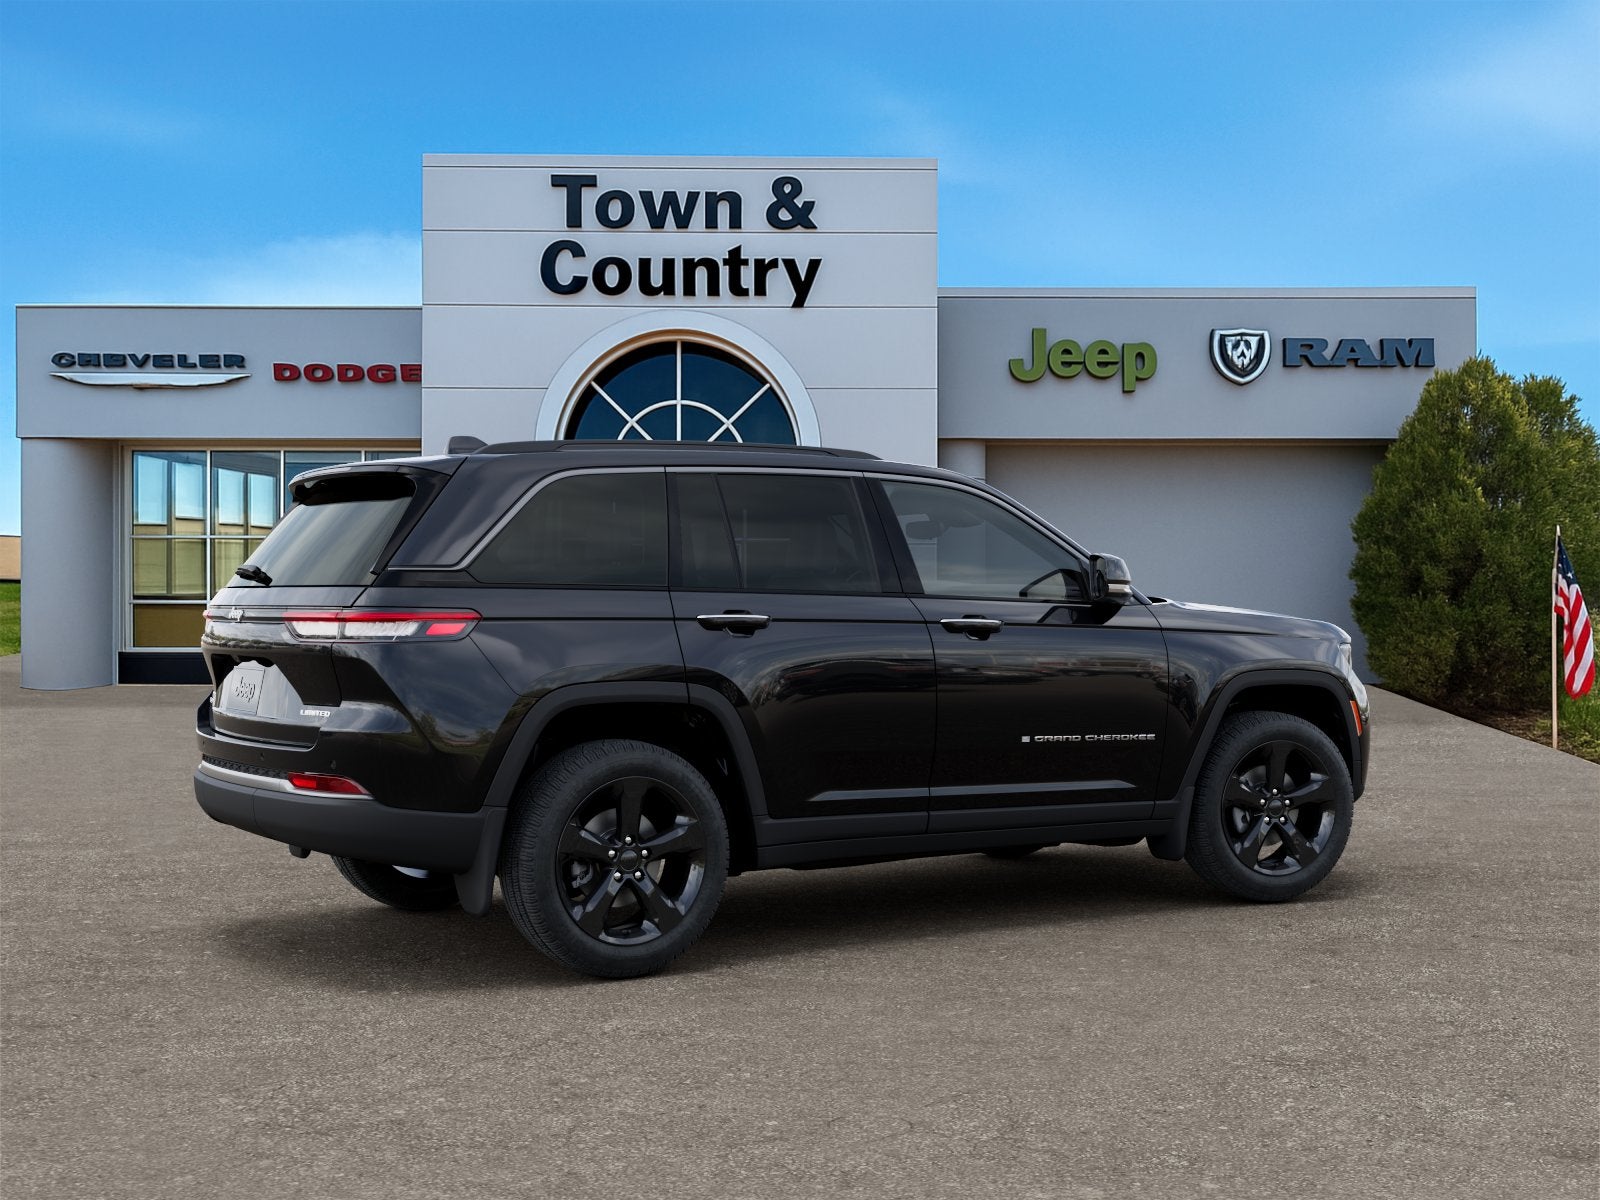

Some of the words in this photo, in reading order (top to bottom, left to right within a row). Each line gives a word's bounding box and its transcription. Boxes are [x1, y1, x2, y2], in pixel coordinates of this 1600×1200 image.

[550, 174, 742, 229] Town
[766, 176, 818, 230] &
[540, 239, 822, 308] Country
[272, 362, 422, 383] DODGE
[1009, 328, 1158, 392] Jeep
[1282, 337, 1436, 368] RAM
[300, 709, 331, 718] LIMITED
